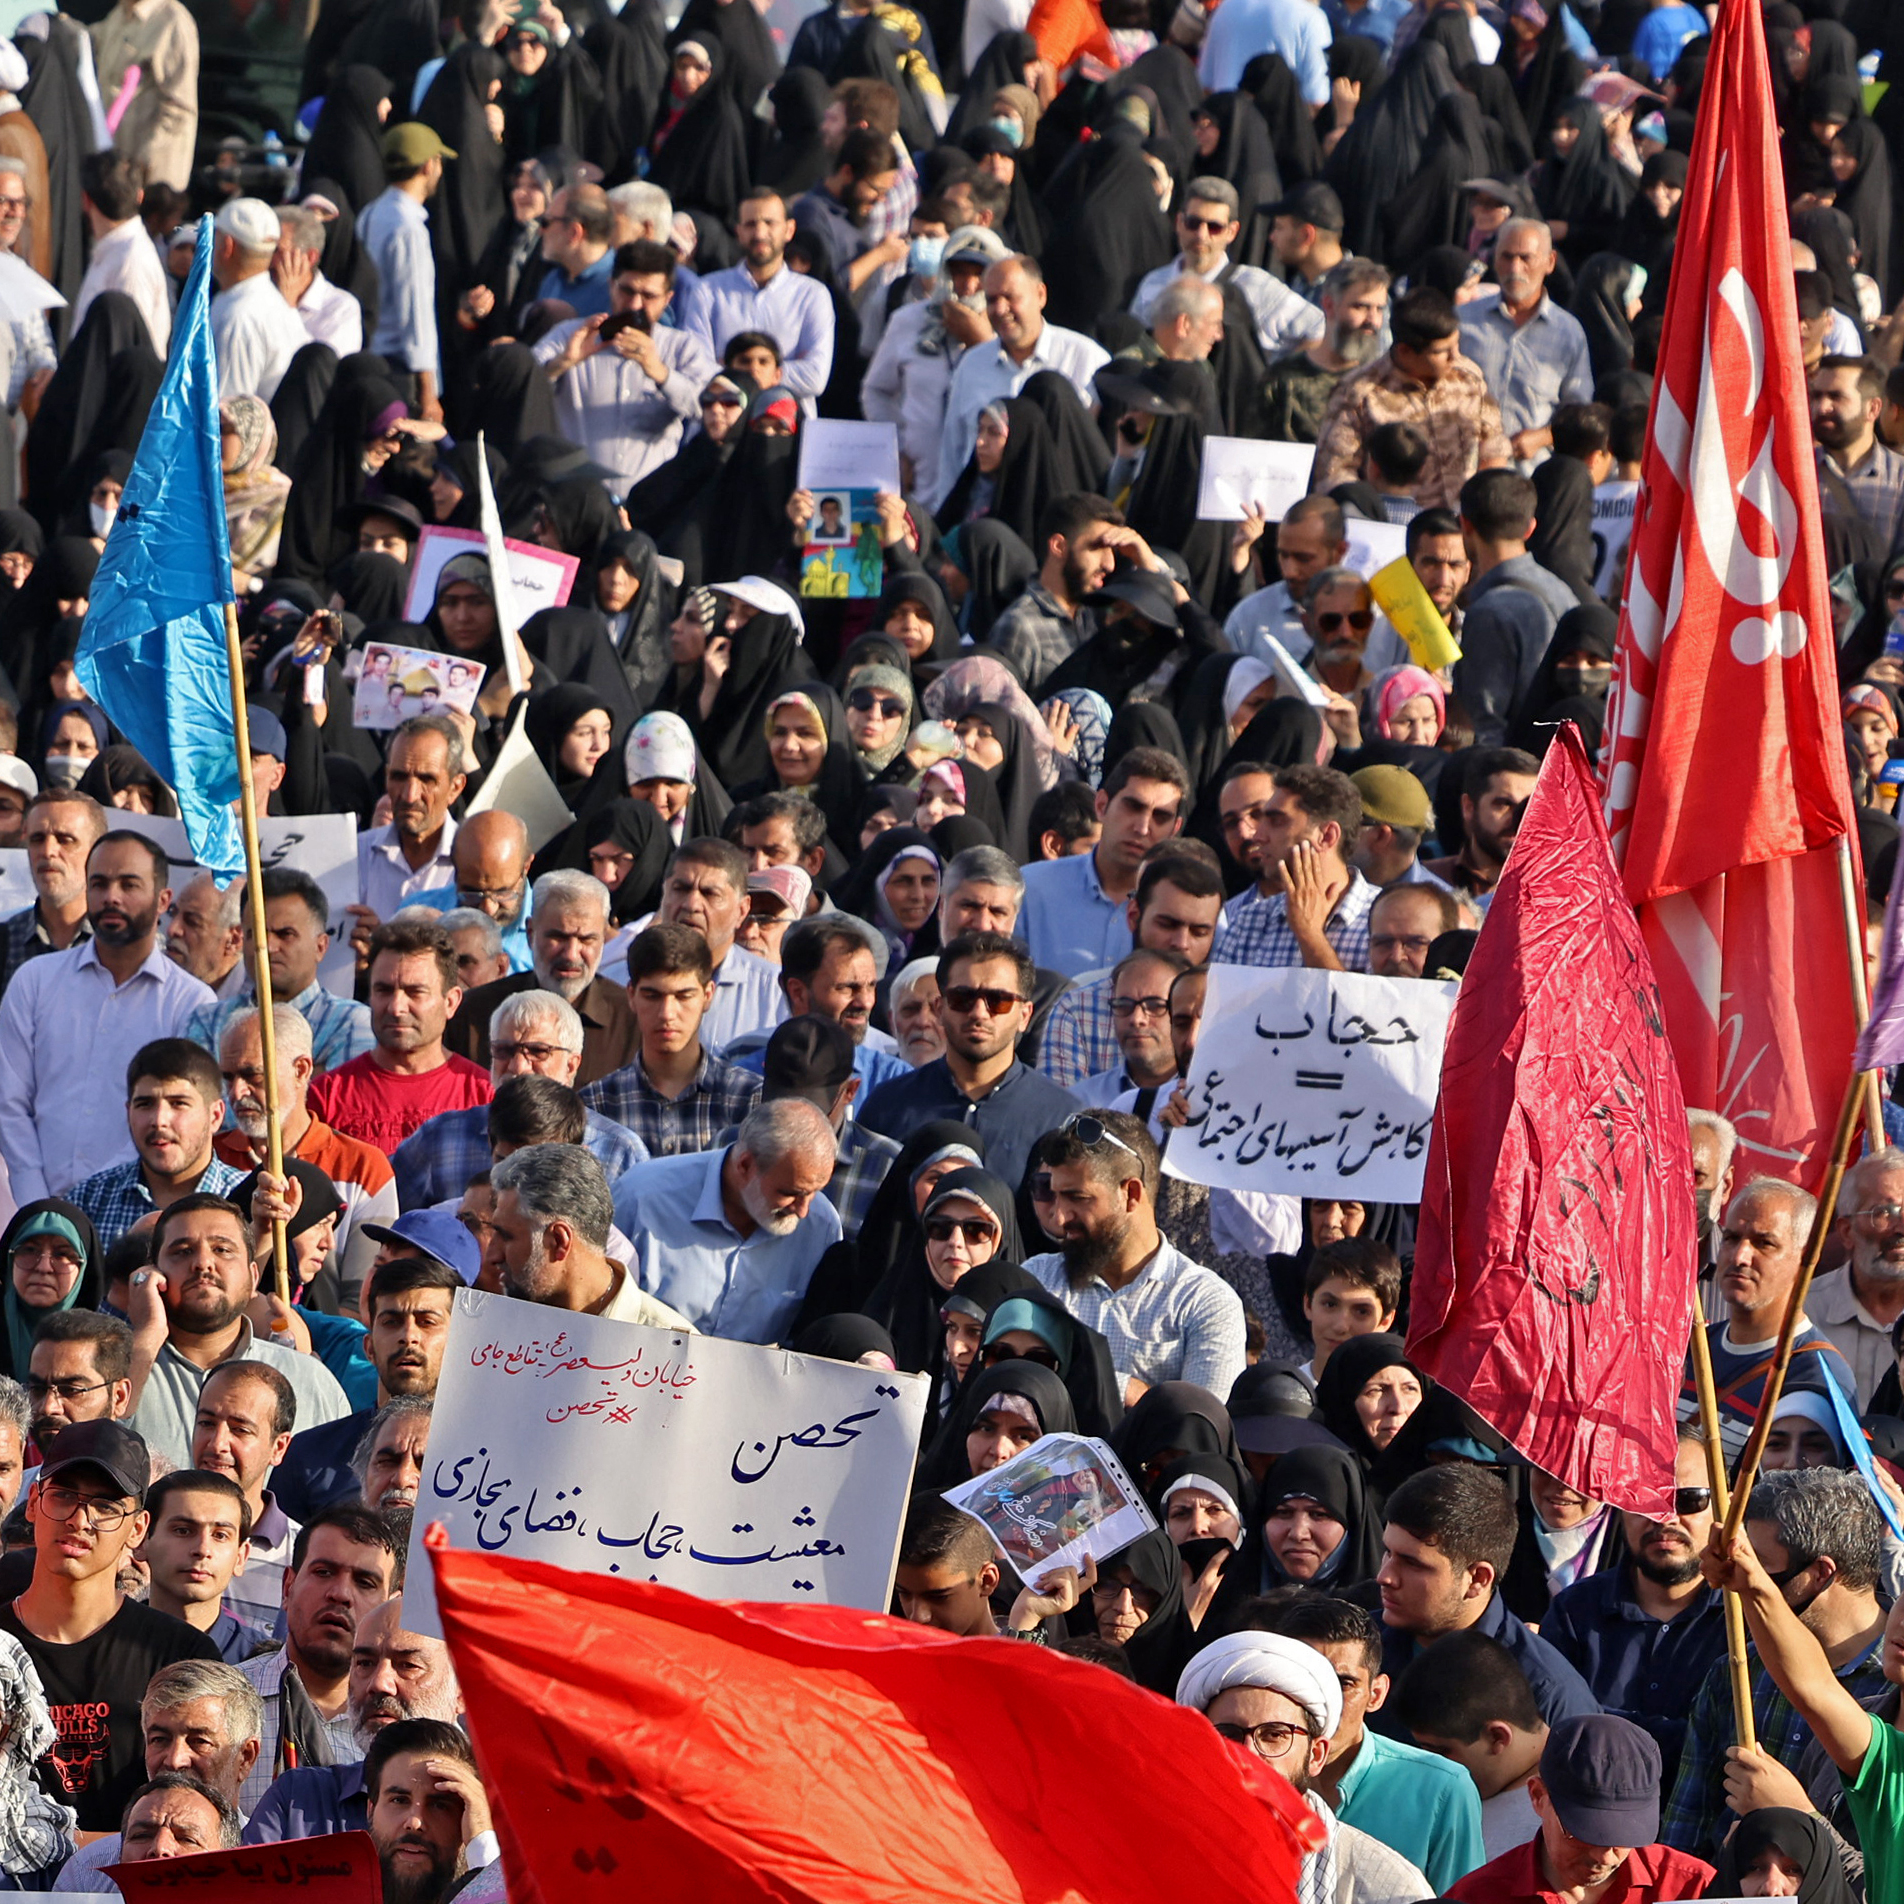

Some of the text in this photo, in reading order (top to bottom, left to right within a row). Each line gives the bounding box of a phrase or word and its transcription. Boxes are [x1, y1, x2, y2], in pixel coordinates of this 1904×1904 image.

[1255, 990, 1421, 1058] حجاب
[1336, 1112, 1434, 1177] کاهش
[731, 1383, 901, 1484] تحصن
[477, 1486, 584, 1551] فضای
